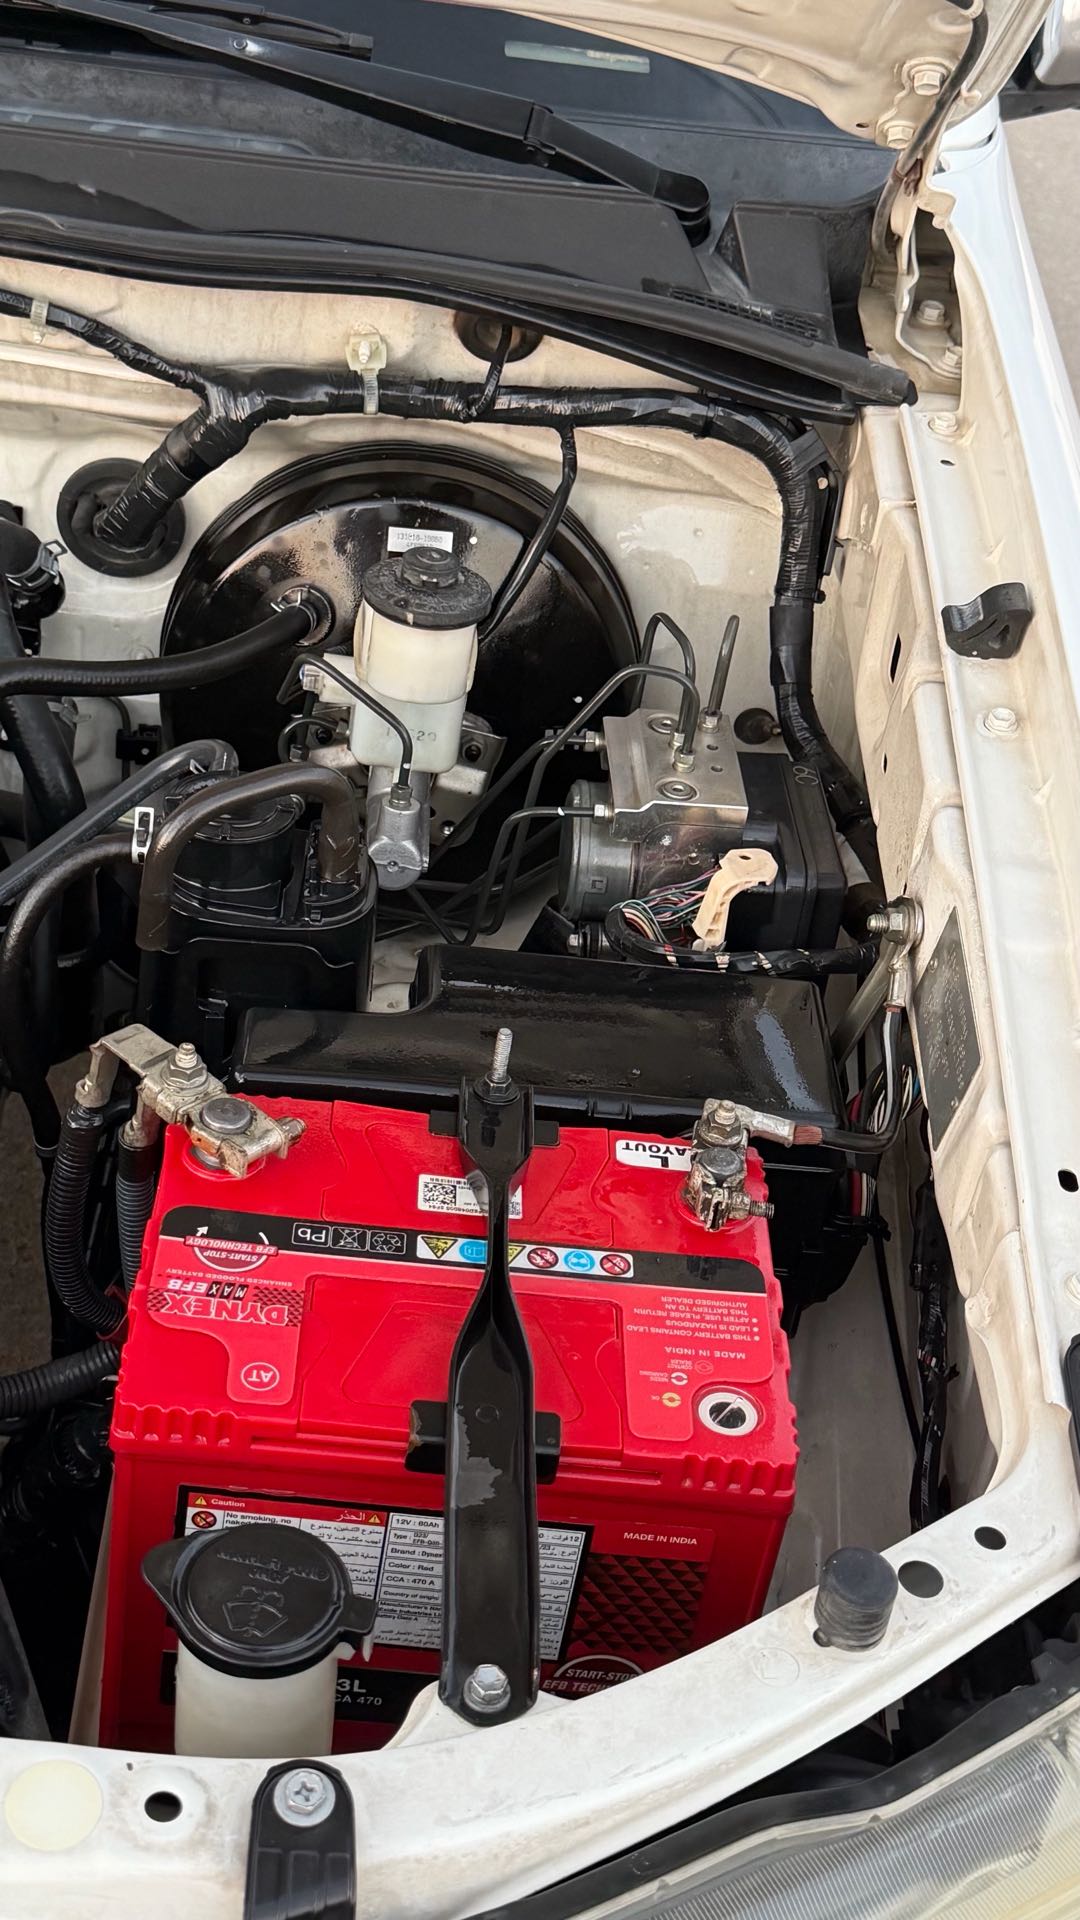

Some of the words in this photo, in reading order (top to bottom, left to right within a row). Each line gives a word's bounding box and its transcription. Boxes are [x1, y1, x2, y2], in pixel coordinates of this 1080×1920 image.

[621, 1142, 692, 1157] AYOUT
[649, 1154, 669, 1168] L
[297, 1226, 326, 1242] Pb
[186, 1237, 253, 1252] TECHNOLOGY
[256, 1245, 276, 1254] EFB
[203, 1250, 258, 1262] START-STOP
[166, 1268, 203, 1277] BATTERY
[205, 1273, 245, 1283] FLOODED
[247, 1277, 293, 1287] ENHANCED
[168, 1279, 207, 1293] EFB
[209, 1283, 248, 1299] MAX
[661, 1296, 694, 1304] DEALER
[695, 1299, 748, 1308] AUTHORISED
[163, 1292, 289, 1326] DYNEX
[633, 1308, 667, 1316] RETURN
[692, 1305, 728, 1314] BATTERY
[669, 1311, 700, 1319] PLEASE
[723, 1315, 750, 1323] AFTER
[626, 1324, 648, 1333] LEAD
[665, 1319, 717, 1329] HAZARDOUS
[649, 1327, 692, 1337] CONTAINS
[693, 1331, 731, 1340] BATTERY
[664, 1346, 695, 1355] INDIA
[699, 1349, 710, 1357] IN
[714, 1350, 746, 1359] MADE
[248, 1370, 274, 1382] AT
[211, 1498, 246, 1508] Caution
[240, 1514, 279, 1524] smoking,
[336, 1510, 366, 1521] الحذر
[395, 1518, 412, 1526] 12V
[623, 1532, 655, 1541] MADE
[669, 1536, 697, 1545] INDIA
[390, 1547, 416, 1555] Brand
[388, 1561, 411, 1569] Color
[386, 1575, 405, 1583] CCA
[383, 1590, 409, 1598] Country
[336, 1679, 367, 1693] 3L
[356, 1696, 383, 1706] 470
